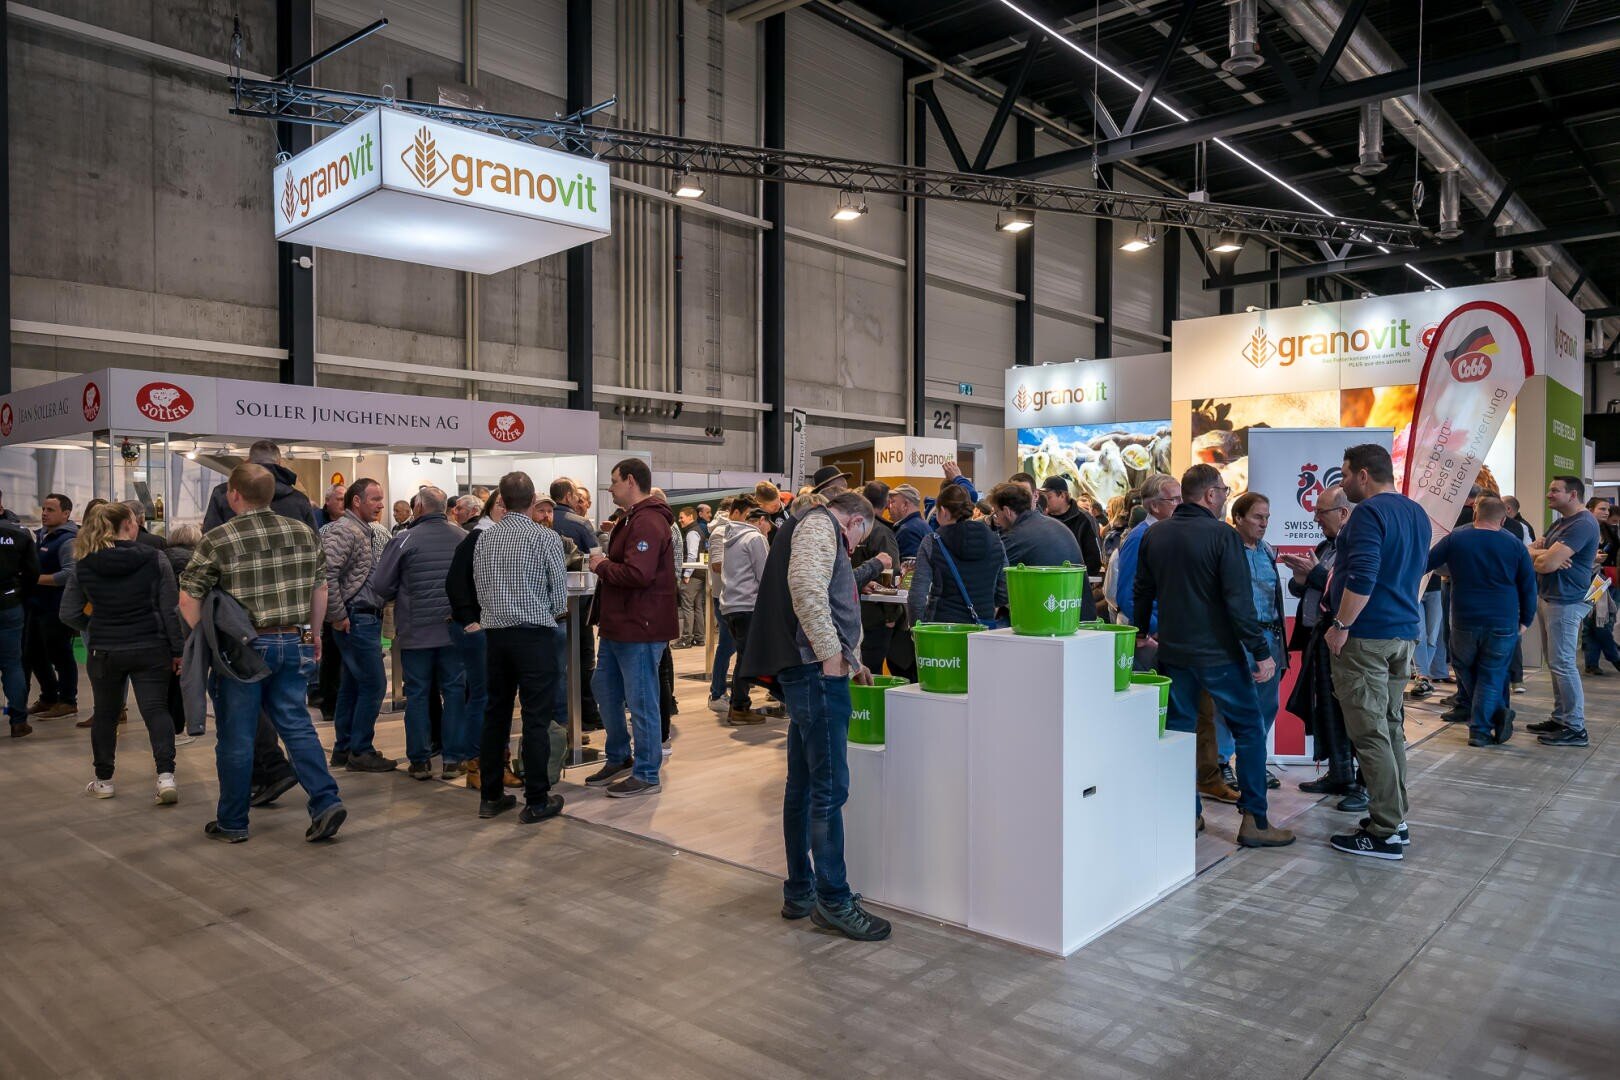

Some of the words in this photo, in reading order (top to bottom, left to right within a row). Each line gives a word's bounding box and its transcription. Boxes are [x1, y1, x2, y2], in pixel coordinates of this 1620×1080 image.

[300, 133, 374, 218] granovit
[451, 153, 597, 213] granovit
[1278, 319, 1411, 367] granovit
[1457, 355, 1487, 379] Cobb
[1033, 381, 1108, 412] granovit
[18, 407, 32, 425] JEAN
[33, 401, 57, 421] SOLLER
[58, 398, 70, 416] AG
[141, 403, 190, 421] SOLLER
[235, 399, 306, 421] SOLLER
[311, 405, 431, 429] JUNGHENNEN
[435, 415, 460, 430] AG
[933, 410, 952, 430] 22
[490, 427, 522, 442] SOLLER
[876, 450, 904, 465] INFO
[1429, 458, 1454, 497] Beste
[1284, 521, 1314, 530] SWISS
